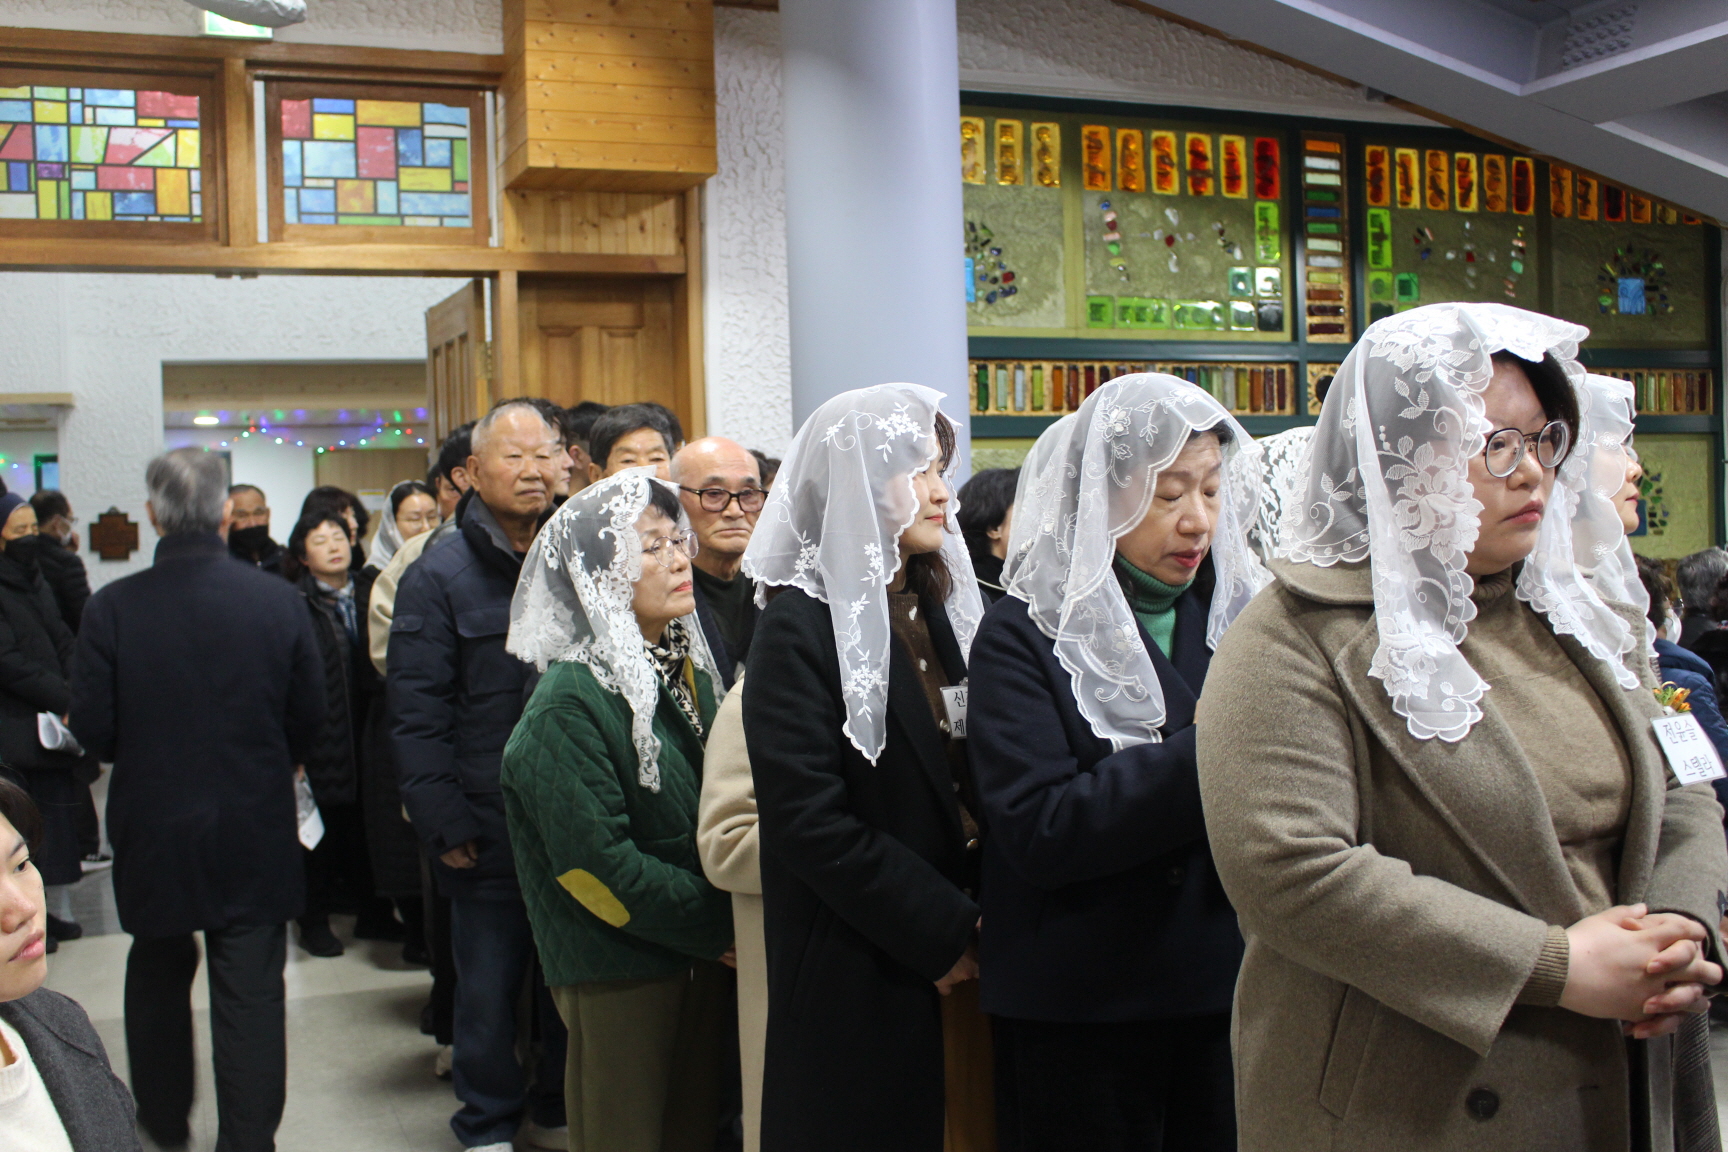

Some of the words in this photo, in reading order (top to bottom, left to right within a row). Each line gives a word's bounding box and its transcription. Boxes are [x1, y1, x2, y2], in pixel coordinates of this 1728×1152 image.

[954, 690, 968, 708] 신
[1662, 719, 1698, 744] 전윤슬
[1683, 754, 1716, 777] 스텔라
